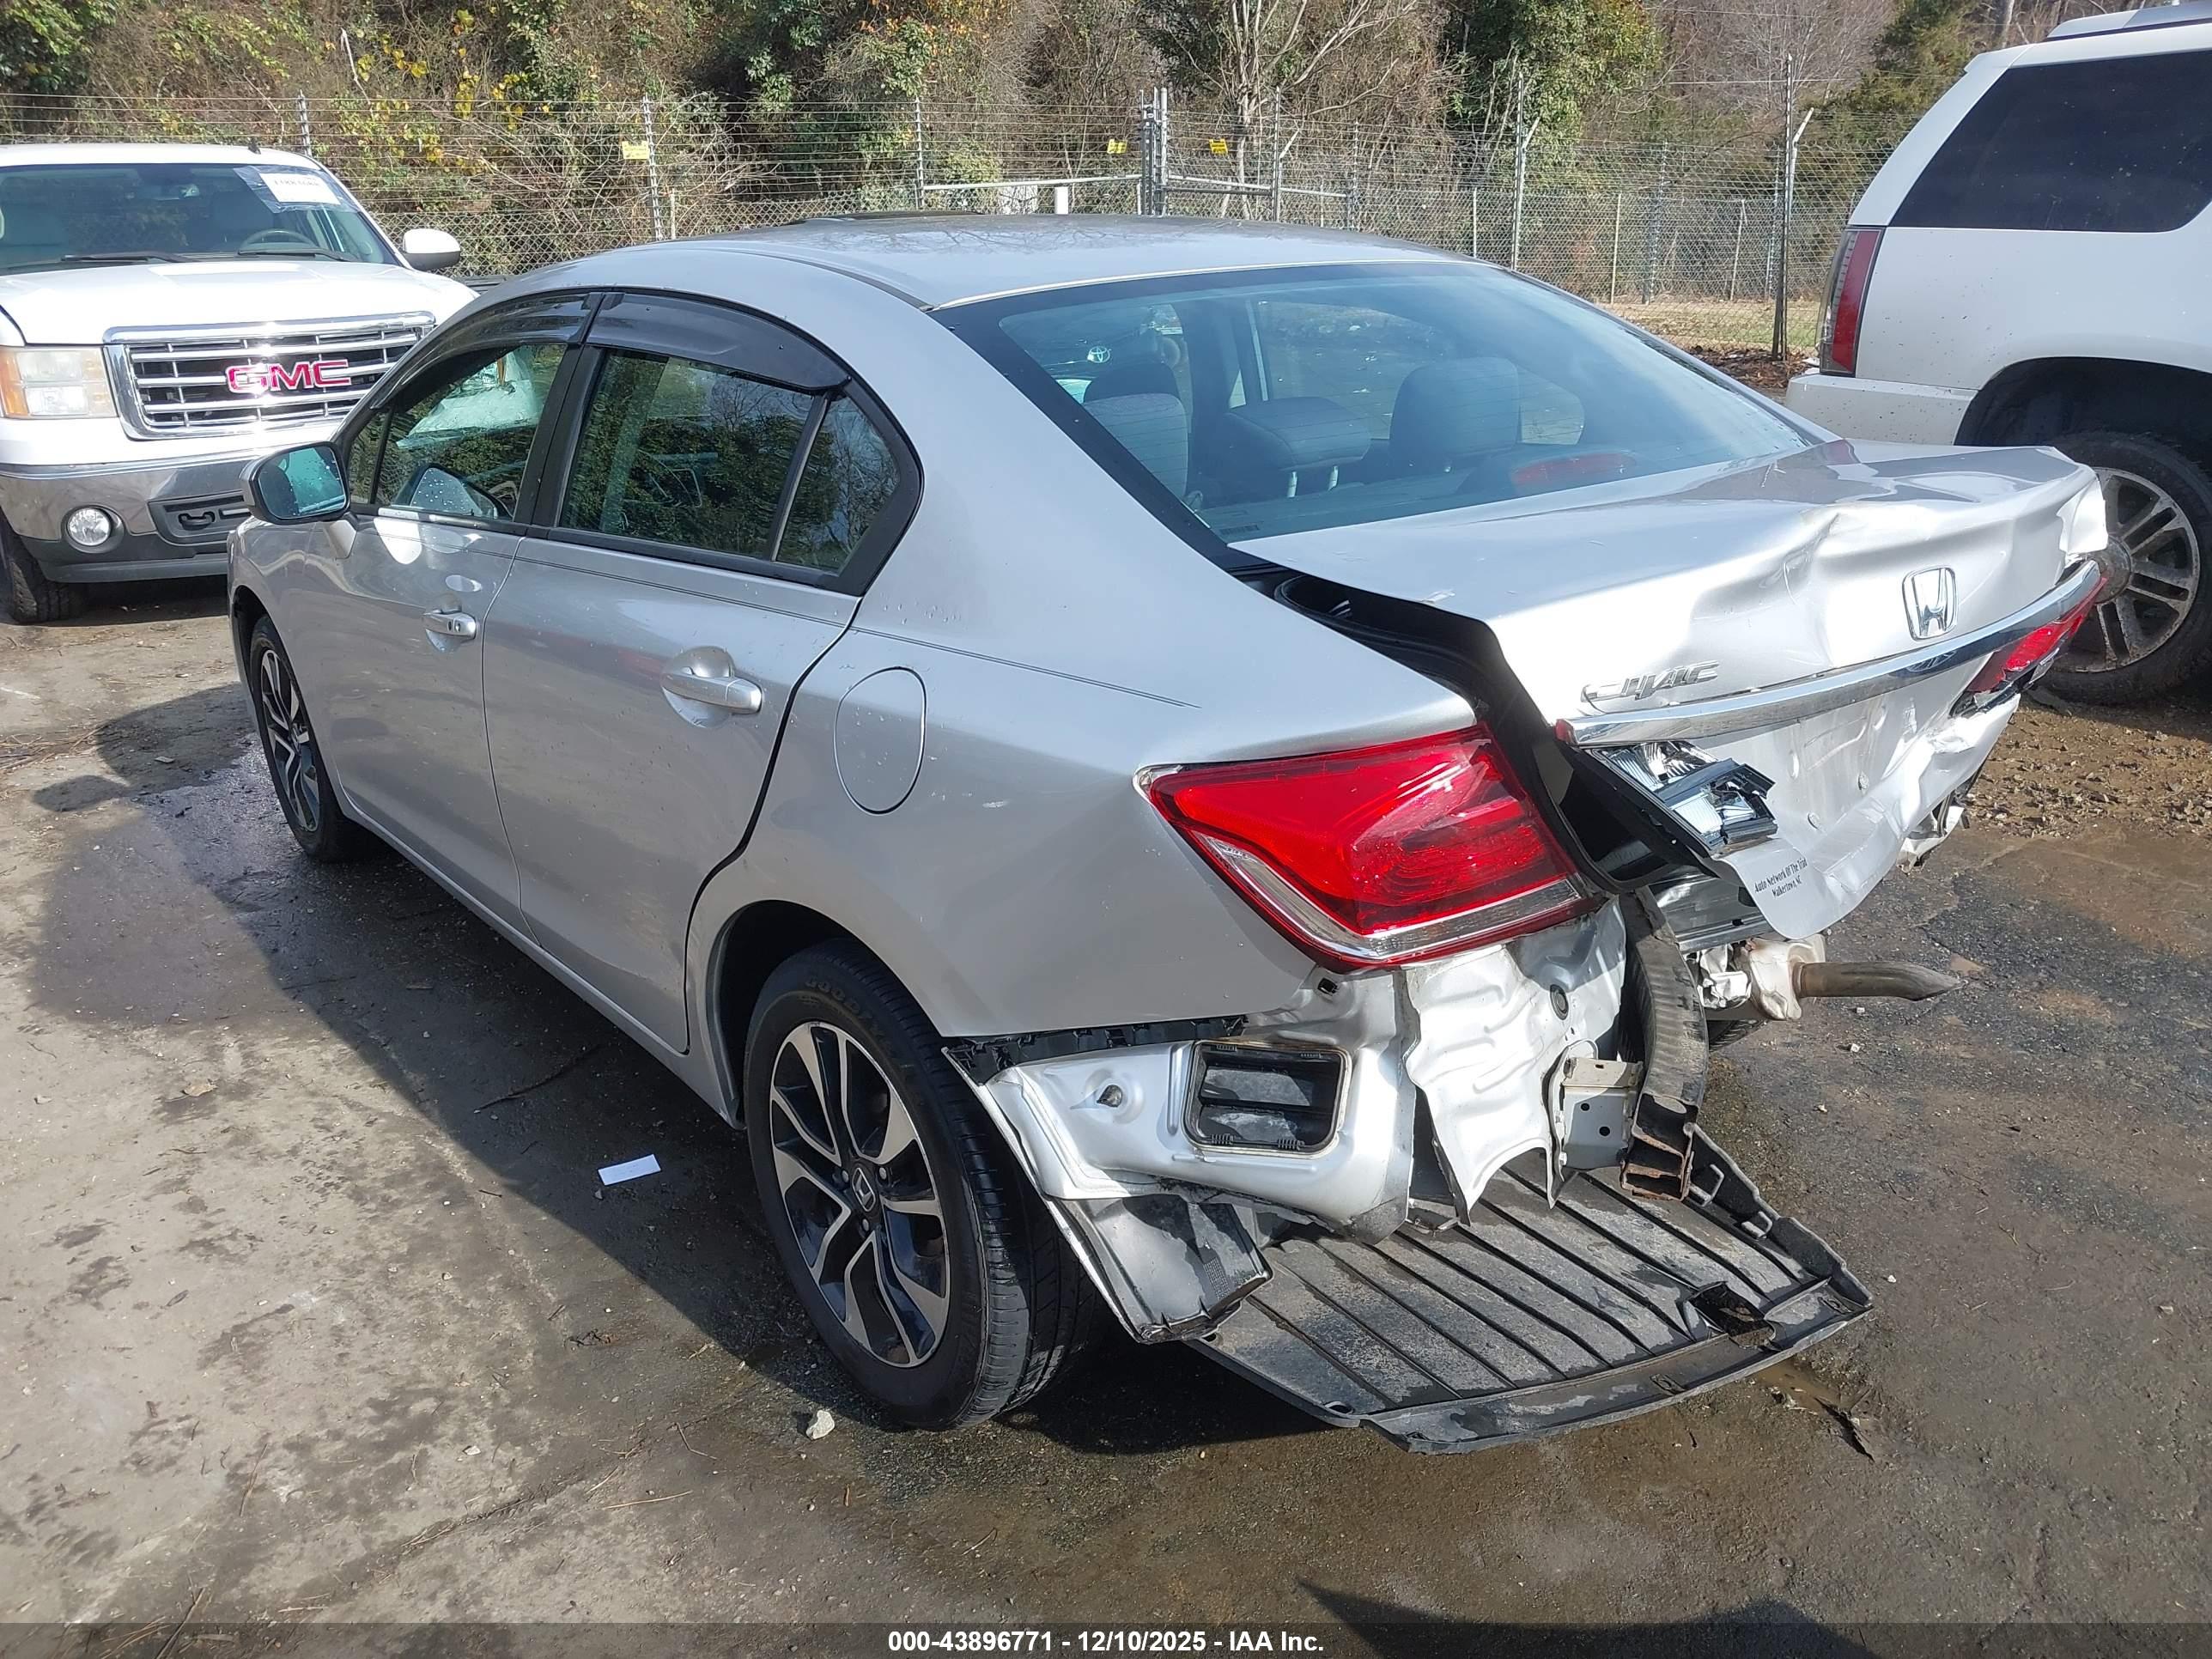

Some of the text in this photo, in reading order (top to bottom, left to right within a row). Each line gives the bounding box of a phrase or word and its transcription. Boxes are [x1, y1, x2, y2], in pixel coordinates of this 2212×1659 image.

[226, 359, 351, 394] GMC
[1755, 881, 1767, 892] Auto
[1766, 868, 1786, 886] Network
[1790, 863, 1799, 873] The
[1796, 875, 1802, 884] NC
